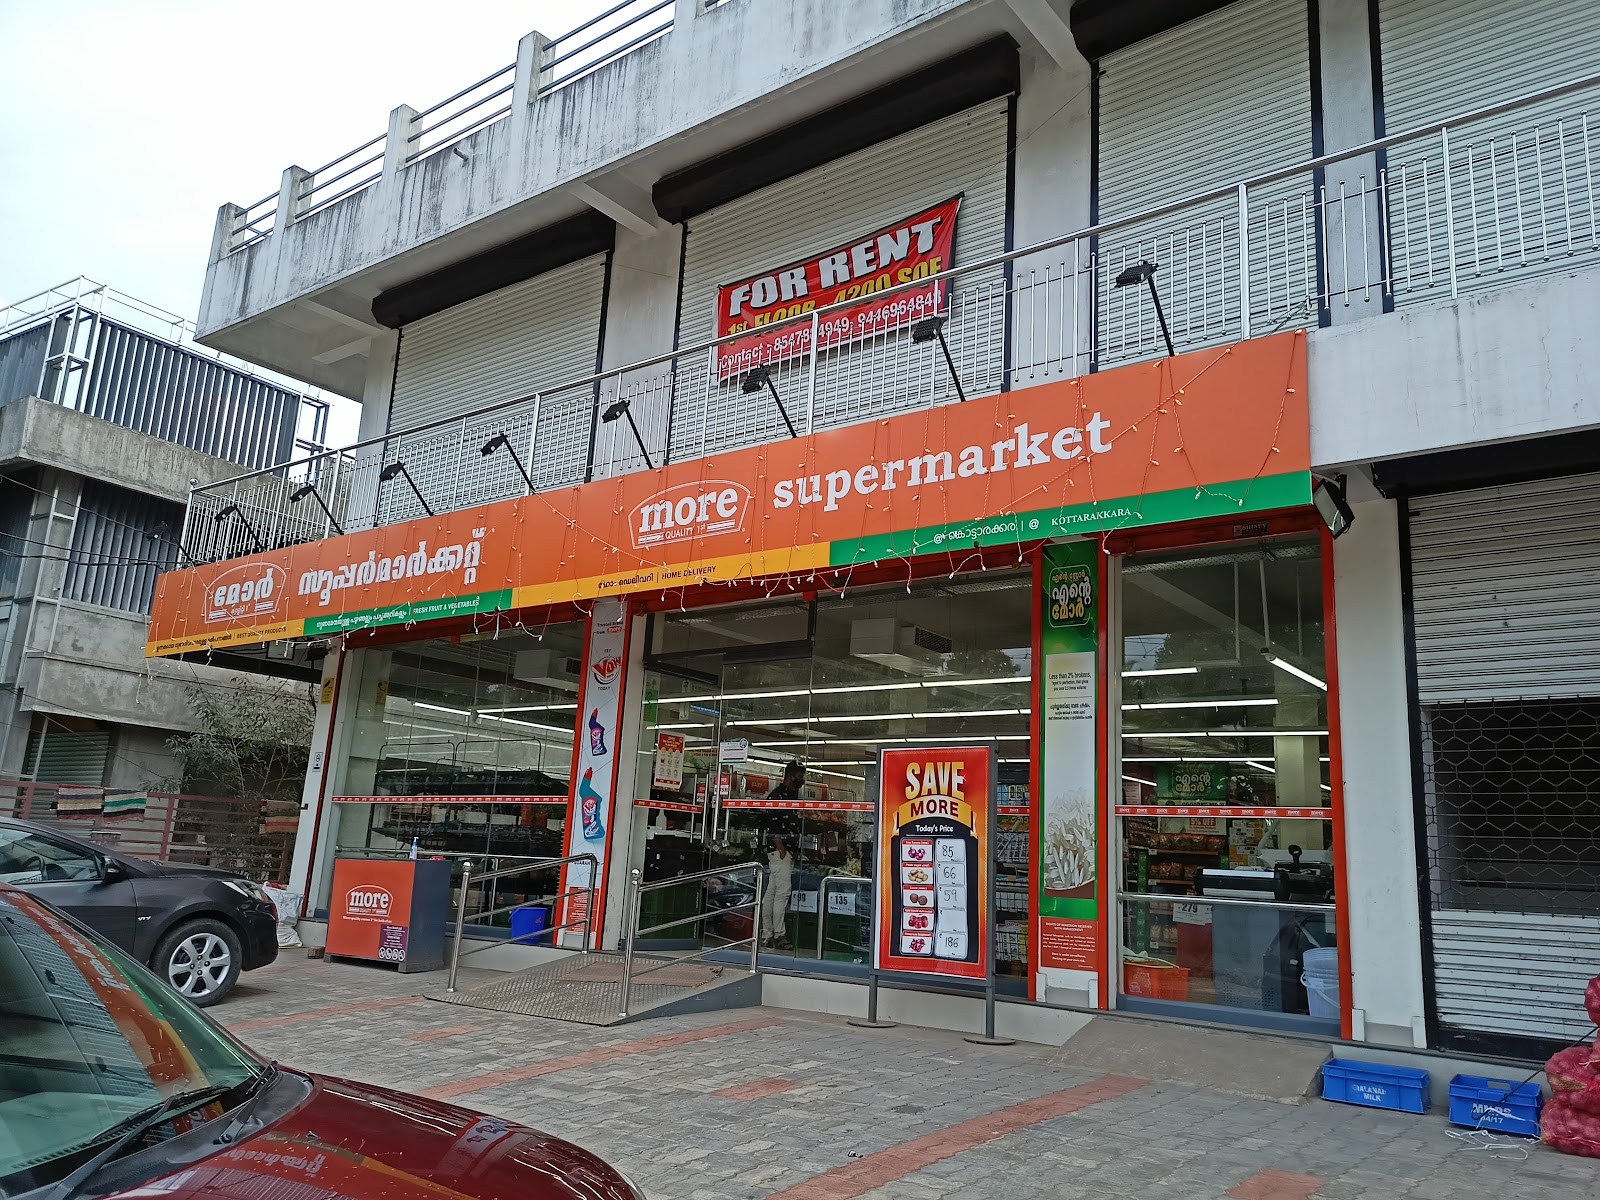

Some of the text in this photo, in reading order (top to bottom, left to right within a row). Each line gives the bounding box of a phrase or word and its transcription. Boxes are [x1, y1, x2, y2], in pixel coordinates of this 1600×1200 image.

[730, 216, 942, 317] FOR RENT
[721, 345, 763, 370] Contact
[772, 411, 1112, 512] supermarket
[638, 483, 739, 534] more
[1050, 507, 1131, 526] KOTTARAKKARA
[664, 527, 694, 539] QUALITY
[661, 564, 717, 579] HOME DELIVERY
[213, 568, 275, 608] മോർ
[412, 606, 427, 615] FRESH
[427, 604, 442, 613] FRUIT
[447, 598, 479, 610] VEGETABLES
[1052, 597, 1085, 620] മോർ
[905, 761, 965, 801] SAVE
[910, 798, 959, 818] MORE
[915, 824, 954, 833] Today's Price
[941, 844, 955, 858] 85
[943, 866, 957, 879] 66
[349, 891, 389, 908] more
[835, 896, 848, 906] 135
[1181, 903, 1198, 913] 279
[944, 936, 959, 948] 186
[1363, 1092, 1381, 1102] MILK
